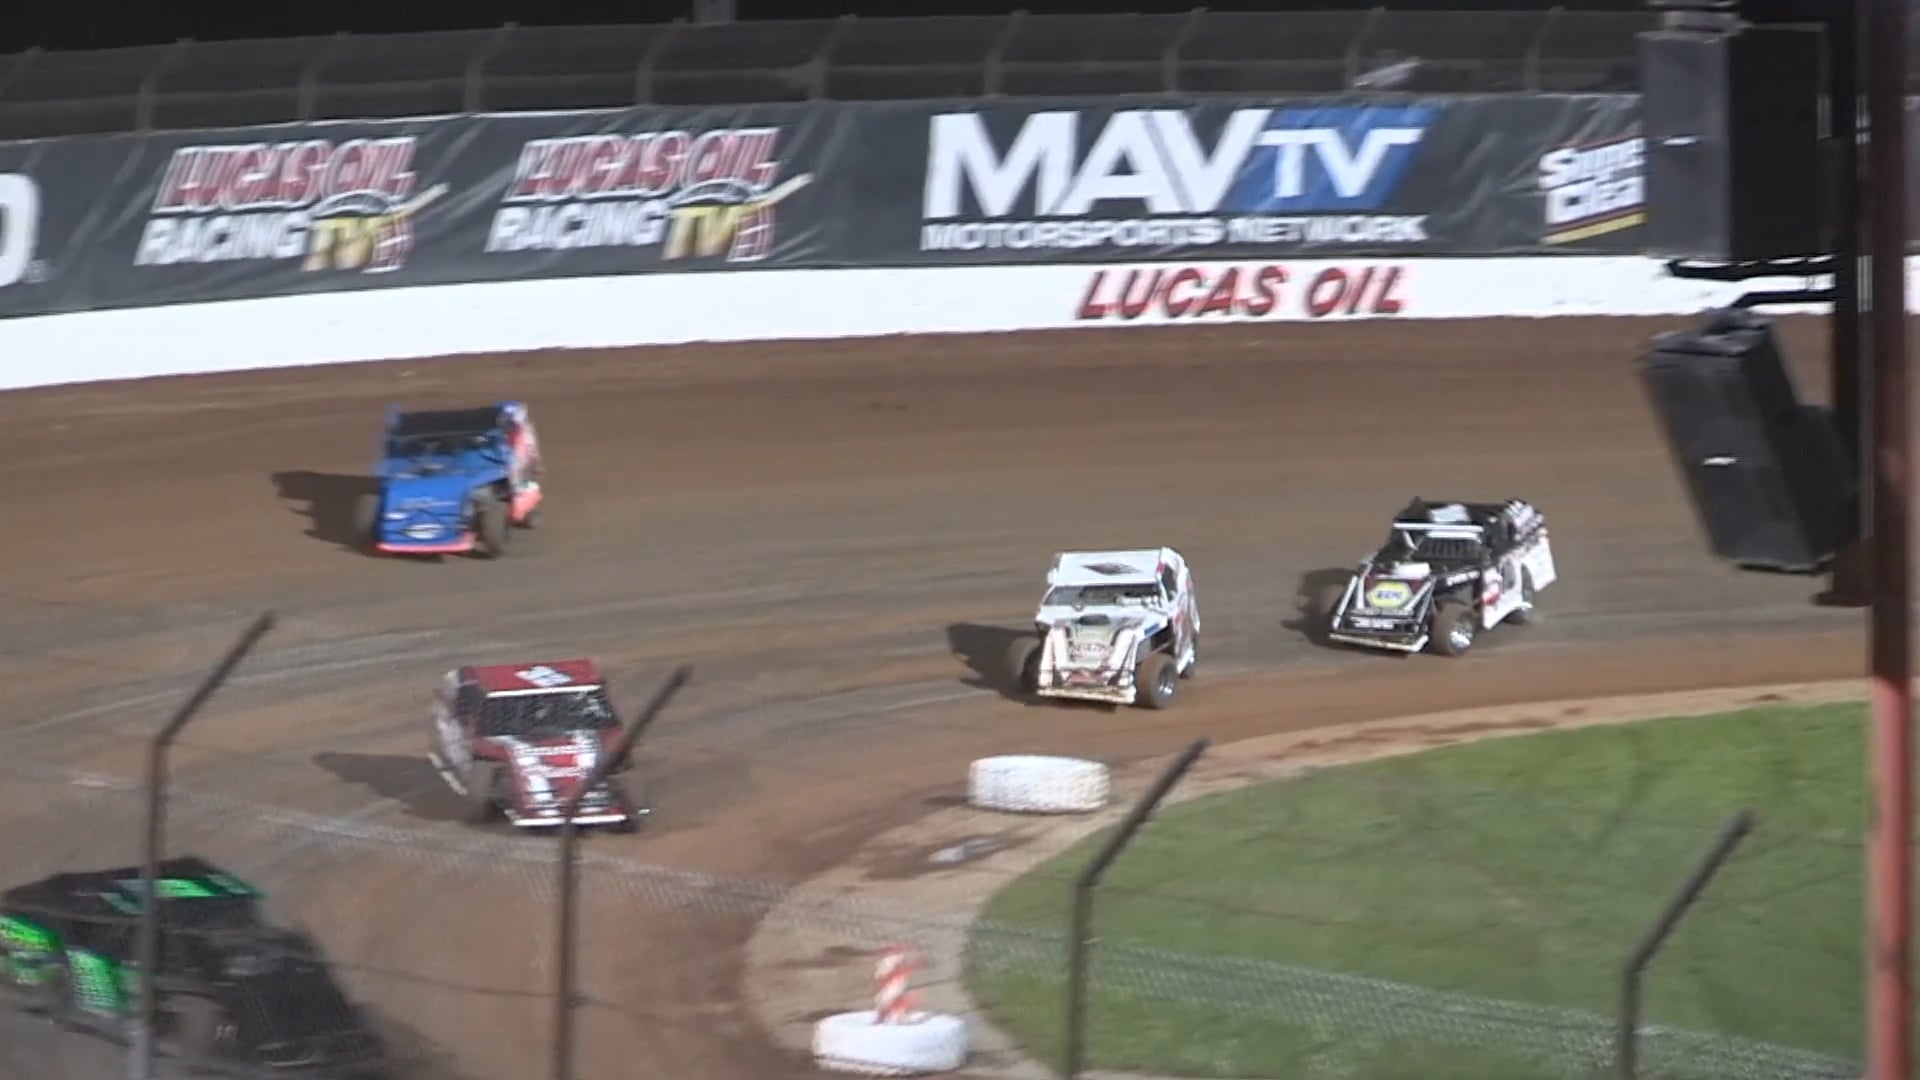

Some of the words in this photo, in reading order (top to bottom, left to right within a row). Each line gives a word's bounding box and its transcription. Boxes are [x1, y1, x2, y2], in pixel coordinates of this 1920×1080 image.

[152, 139, 333, 214] LUCAS
[325, 135, 418, 202] OIL
[500, 130, 690, 202] LUCAS
[680, 126, 781, 194] OIL
[134, 215, 308, 267] RACING
[483, 201, 669, 253] RACING
[920, 217, 1225, 252] MOTORSPORTS
[1229, 214, 1430, 244] NETWORK
[1075, 265, 1288, 320] LUCAS
[1304, 265, 1409, 318] OIL
